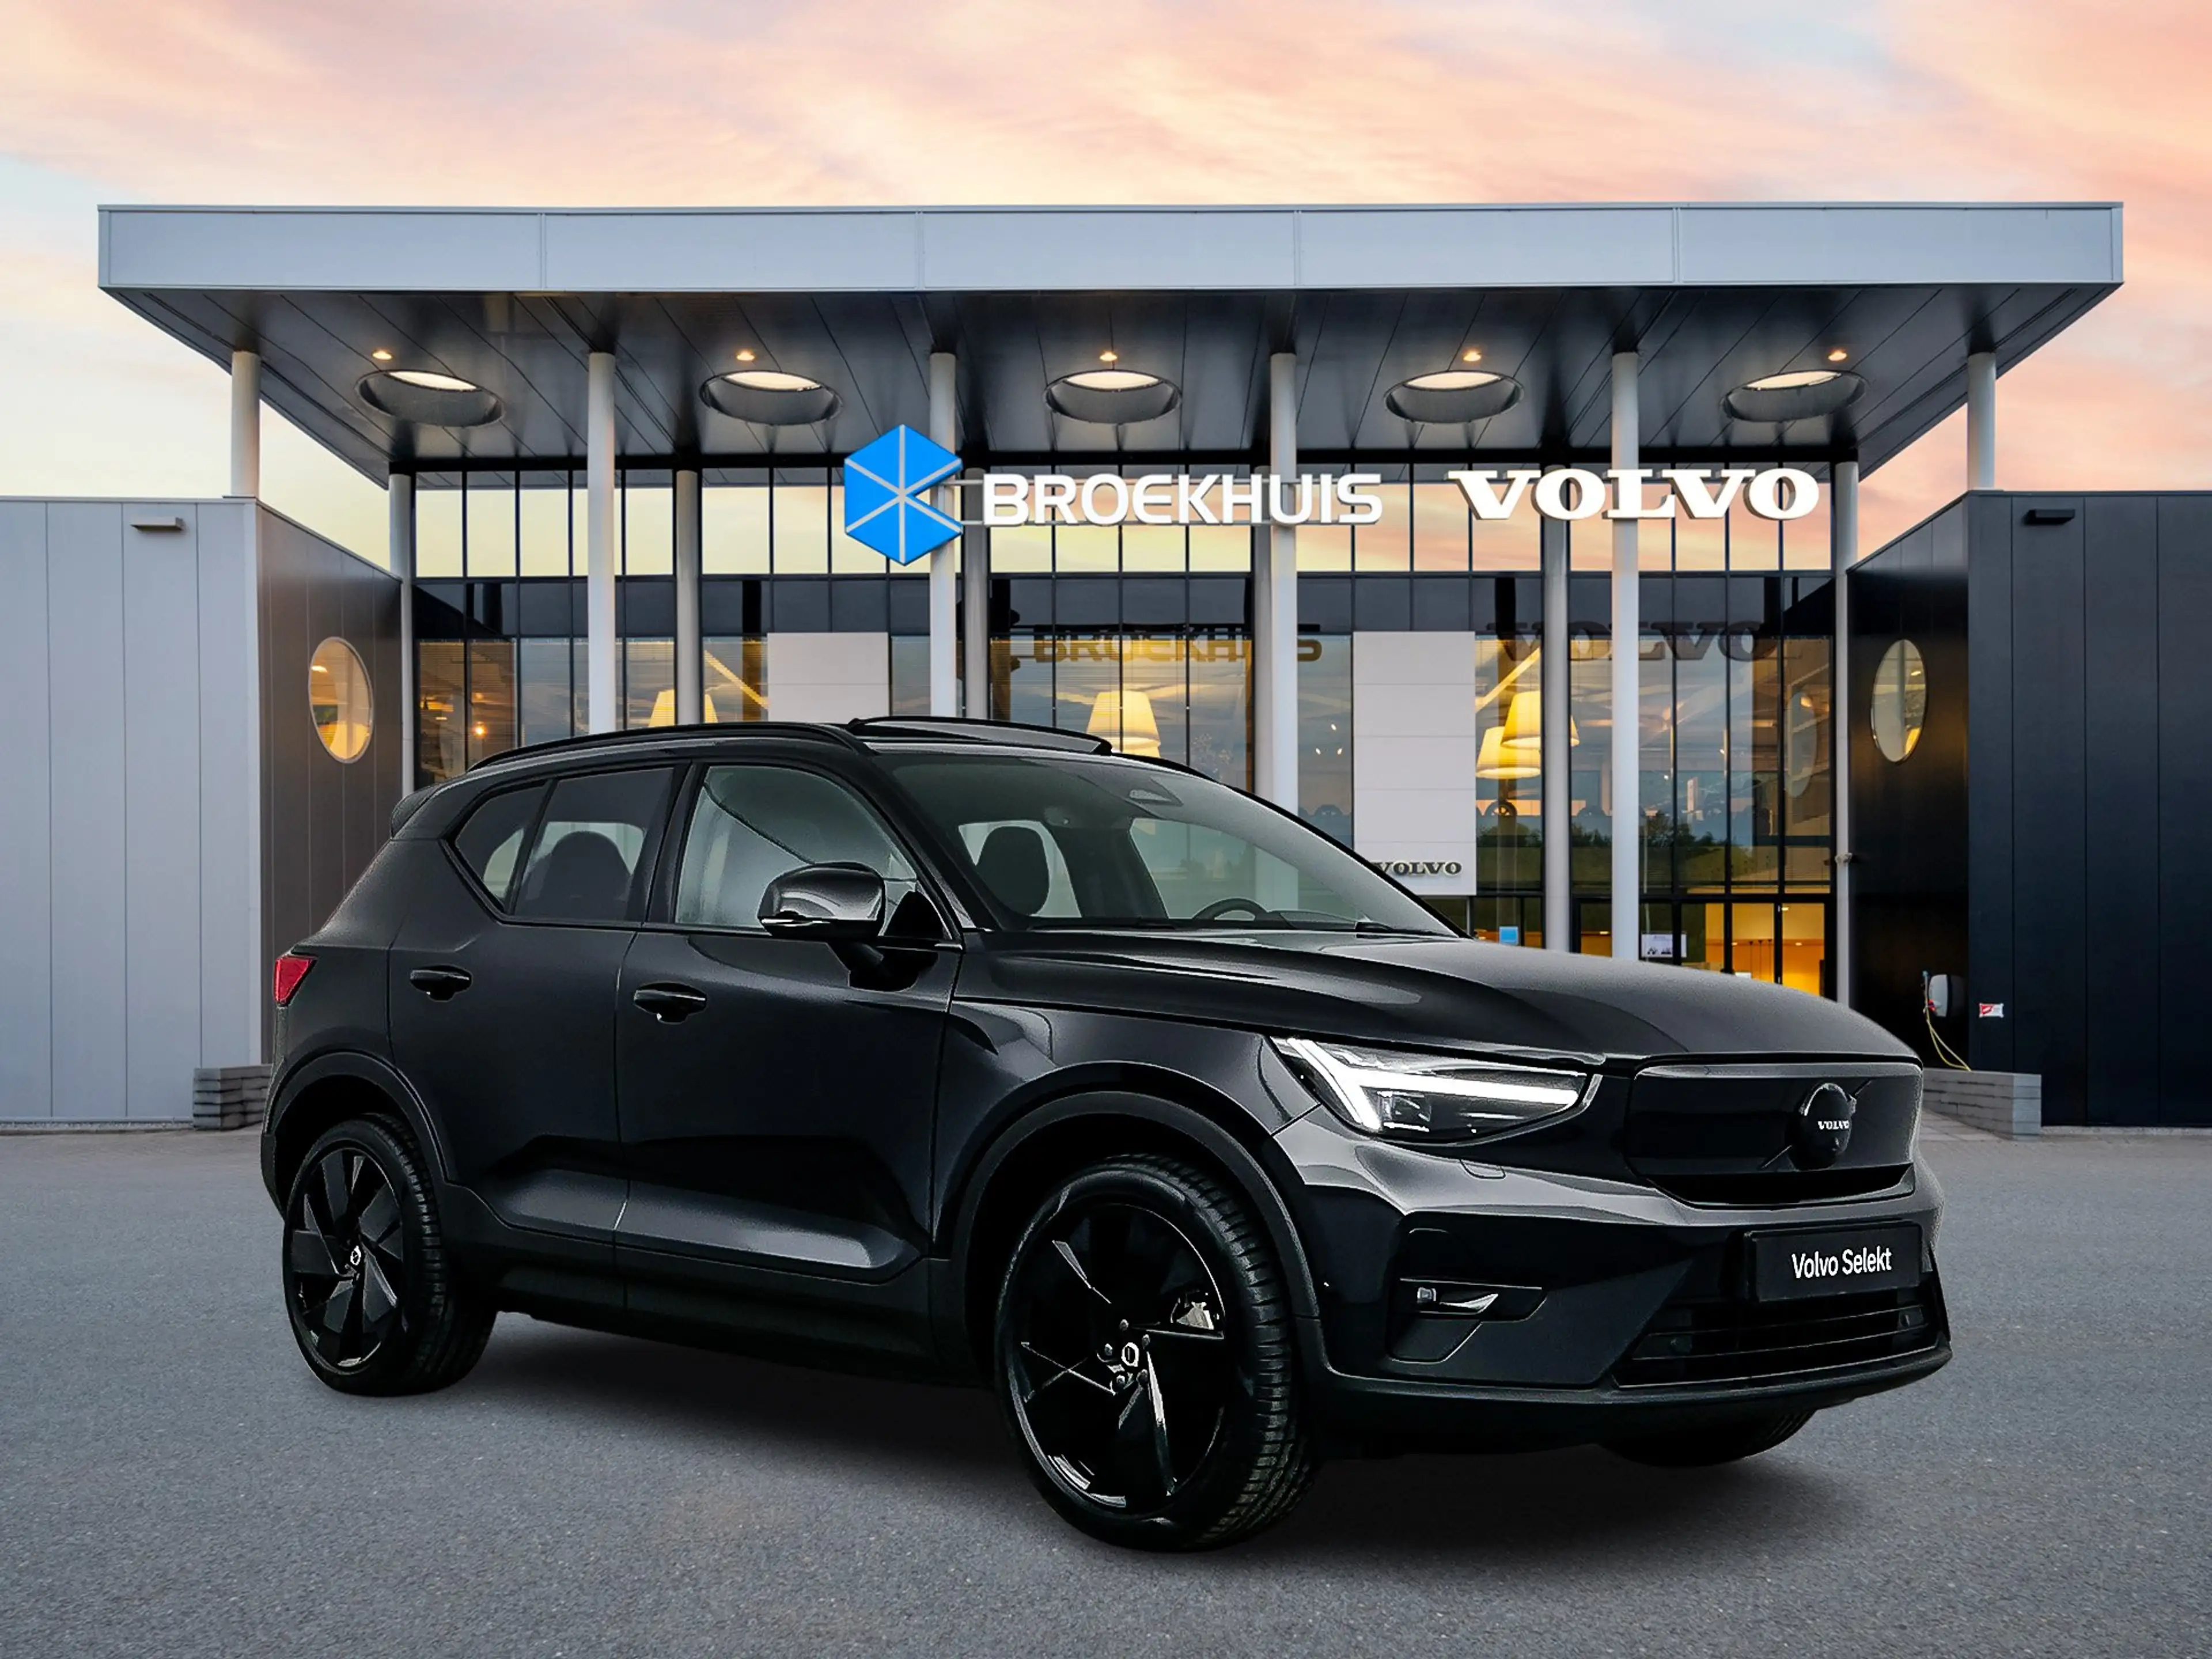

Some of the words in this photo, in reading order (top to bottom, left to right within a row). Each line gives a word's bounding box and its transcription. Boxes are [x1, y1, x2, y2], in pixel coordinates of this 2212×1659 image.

[982, 473, 1382, 526] BROEKHUIS
[1446, 467, 1820, 520] VOLVO
[1817, 1120, 1850, 1130] VOLVO
[1791, 1251, 1839, 1278] Volvo
[1842, 1245, 1892, 1275] Selekt
